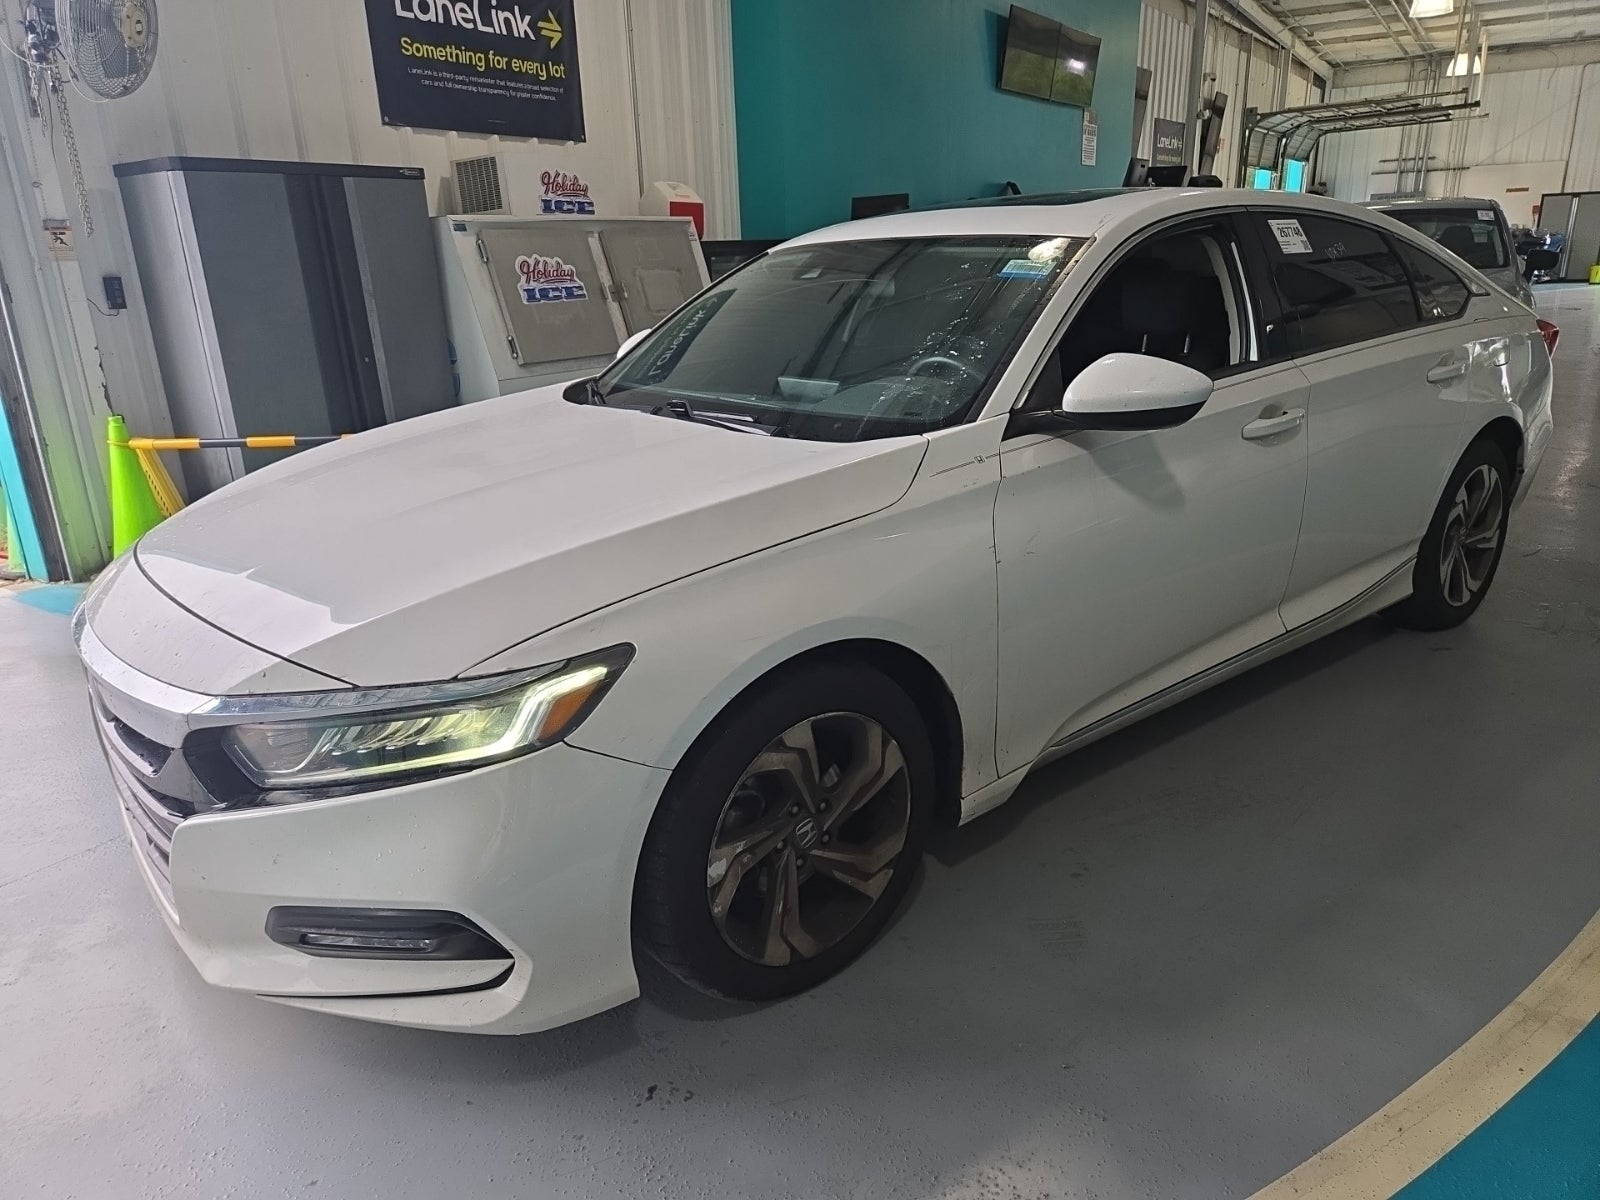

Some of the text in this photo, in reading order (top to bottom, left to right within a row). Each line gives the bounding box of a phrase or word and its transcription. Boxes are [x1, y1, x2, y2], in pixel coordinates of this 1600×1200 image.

[395, 0, 536, 41] LaneLink
[400, 37, 566, 81] Something for every lot
[407, 66, 433, 76] LaneLink
[443, 71, 469, 83] third-party
[444, 80, 453, 88] full
[453, 83, 478, 93] ownership
[1157, 133, 1178, 149] LaneLink
[541, 169, 589, 197] Holiday
[540, 198, 595, 215] ICE
[519, 257, 575, 284] Holiday
[522, 285, 587, 303] ICE
